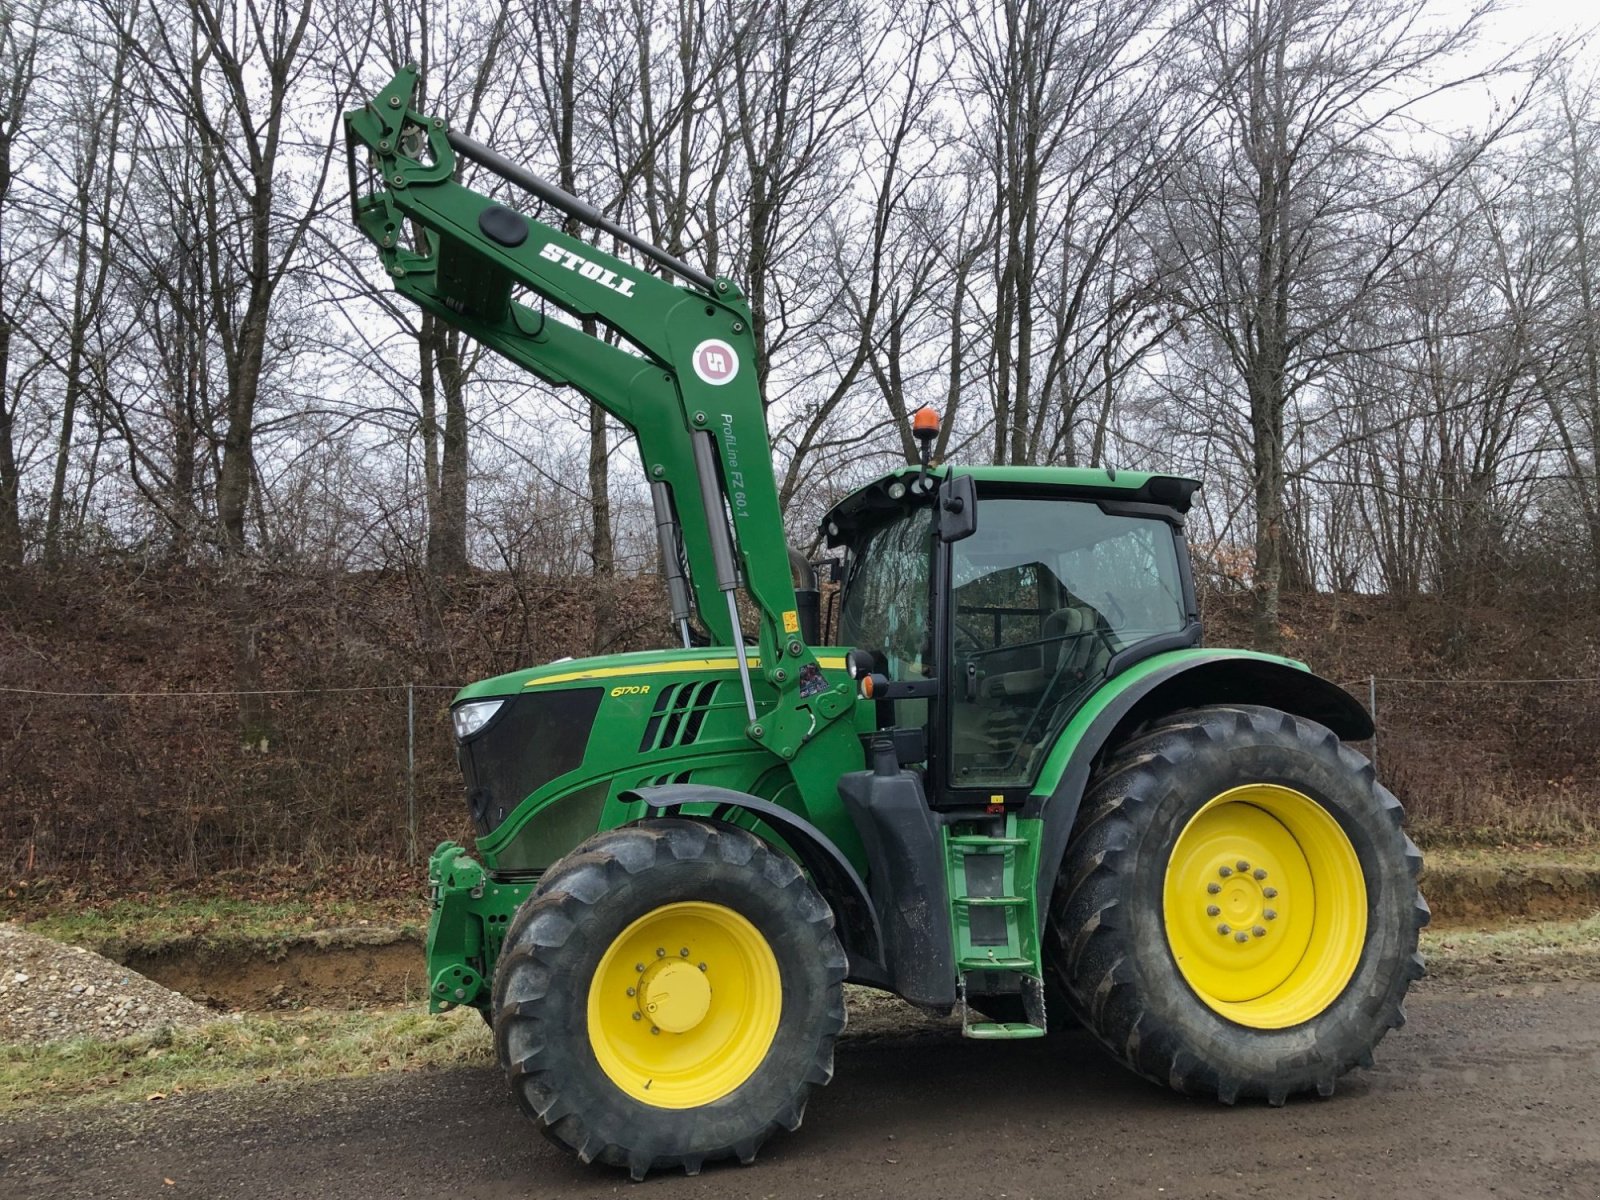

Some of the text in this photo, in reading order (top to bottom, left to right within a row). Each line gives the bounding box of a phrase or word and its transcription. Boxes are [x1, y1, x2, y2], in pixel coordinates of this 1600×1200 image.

[539, 242, 636, 298] STOLL
[720, 413, 749, 517] ProfiLine FZ 60.1
